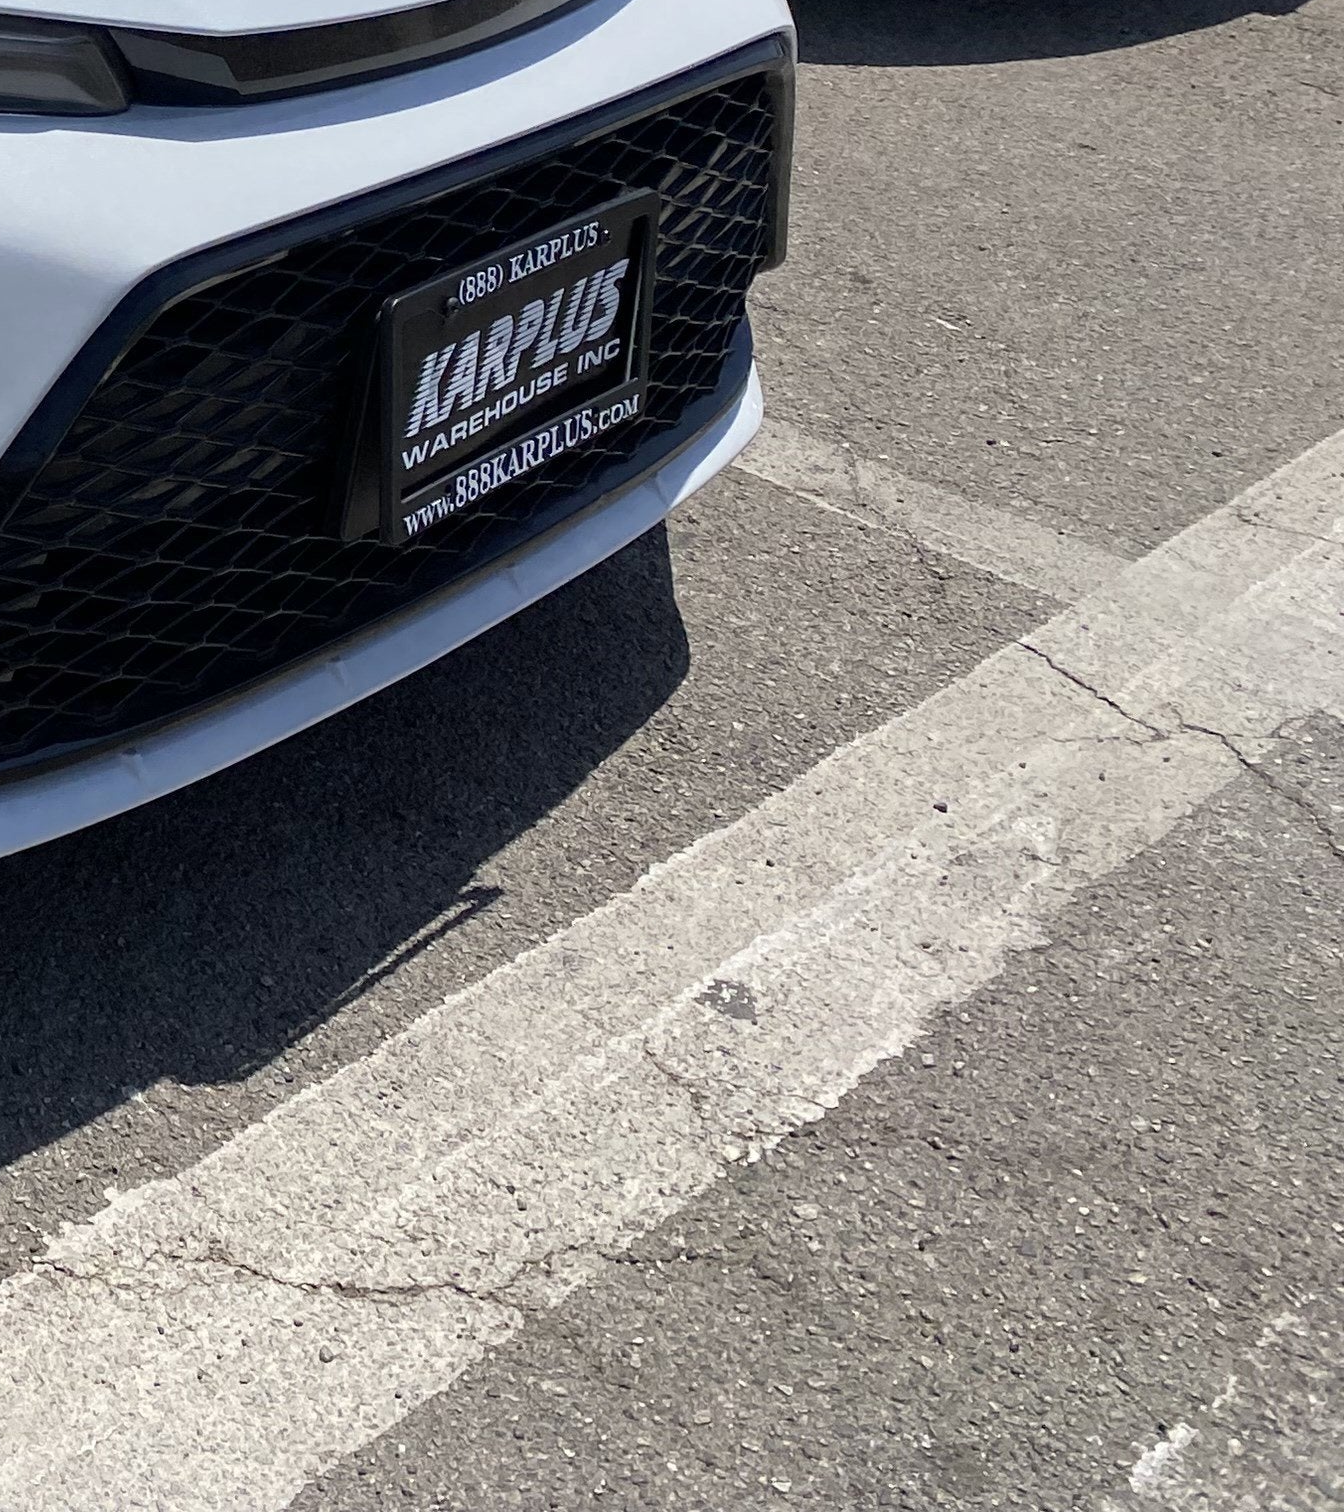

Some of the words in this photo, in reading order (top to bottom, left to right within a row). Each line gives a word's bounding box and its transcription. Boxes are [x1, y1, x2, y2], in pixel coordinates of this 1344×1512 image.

[459, 263, 504, 305] (888)
[508, 221, 600, 283] KARPLUS
[401, 362, 569, 470] WAREHOUSE
[576, 337, 621, 374] INC
[403, 257, 631, 439] KARPLUS
